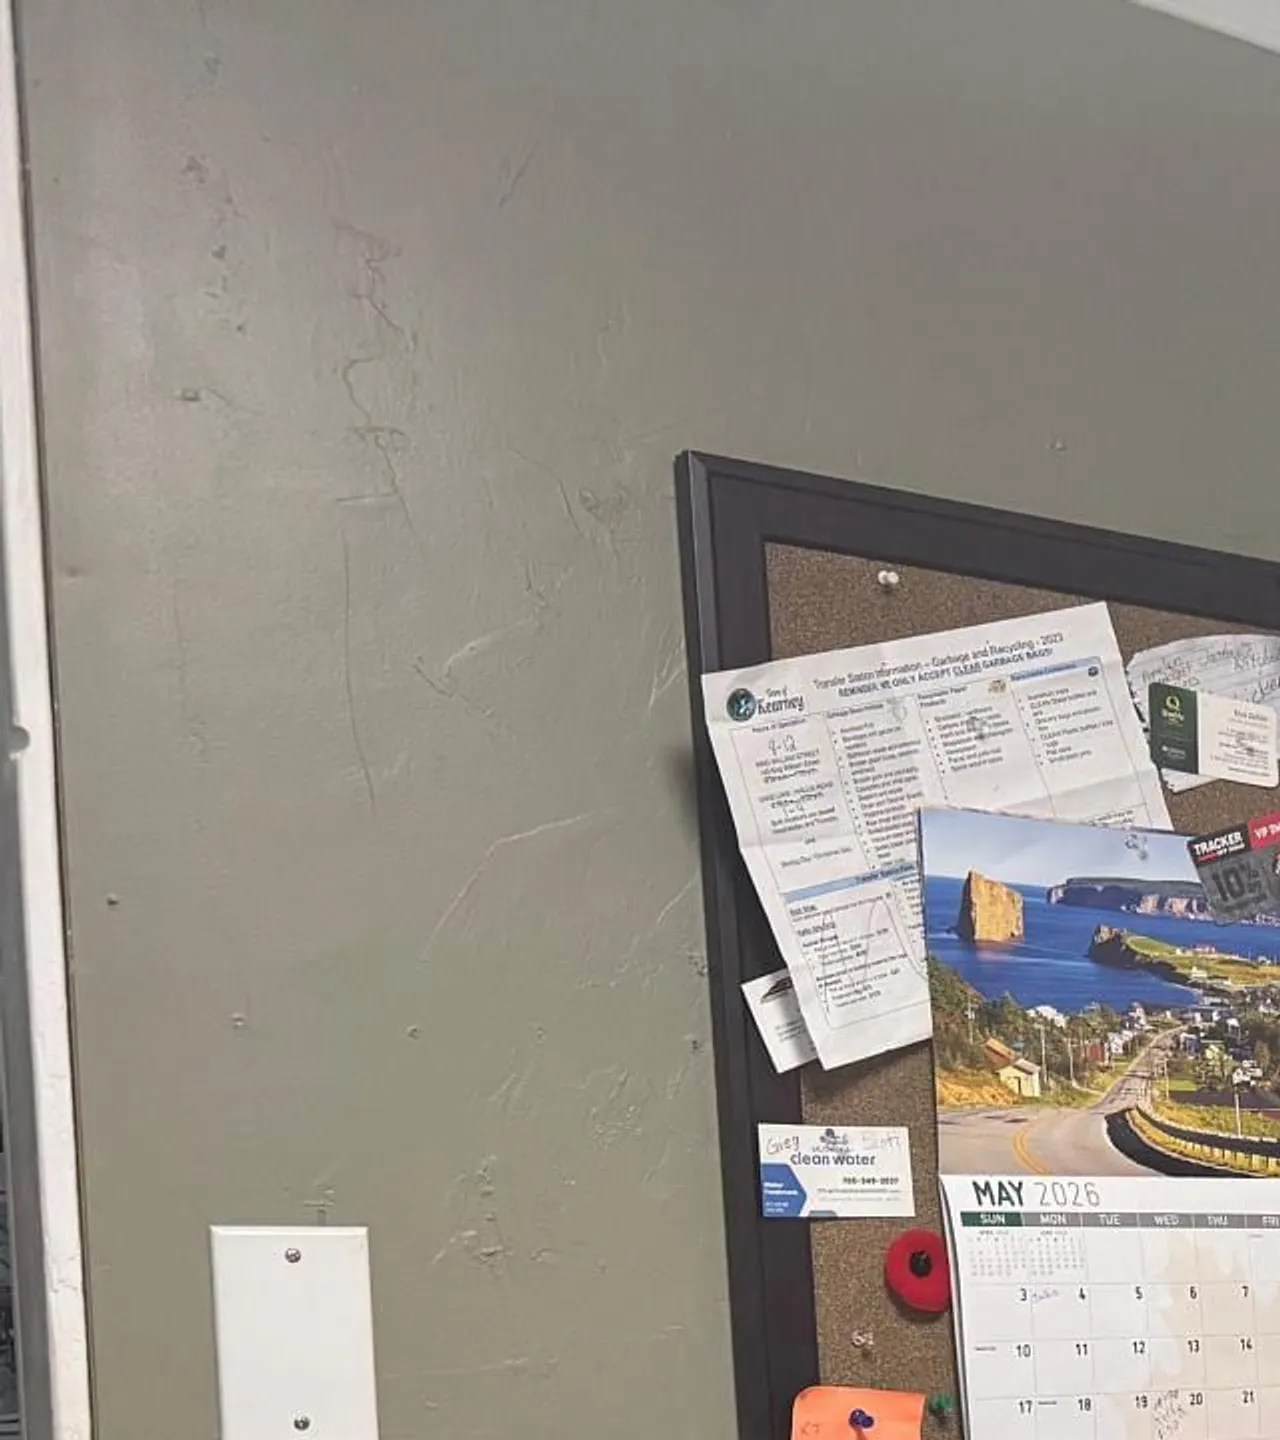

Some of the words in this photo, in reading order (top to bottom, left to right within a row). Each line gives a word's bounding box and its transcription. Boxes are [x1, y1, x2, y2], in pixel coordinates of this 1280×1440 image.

[757, 695, 804, 715] Kearney
[1193, 831, 1244, 857] TRACKER
[790, 1152, 831, 1166] clean
[833, 1153, 877, 1166] water
[972, 1180, 1024, 1207] MAY
[1033, 1181, 1102, 1208] 2026
[979, 1213, 1006, 1225] SUN
[1040, 1213, 1068, 1226] MON
[1099, 1214, 1122, 1226] TUE
[1153, 1214, 1180, 1226] WED
[1261, 1216, 1280, 1227] FRI
[1020, 1288, 1028, 1302] 3
[1078, 1287, 1087, 1301] 4
[1135, 1286, 1143, 1300] 5
[1189, 1285, 1198, 1300] 6
[1016, 1343, 1032, 1358] 10
[1075, 1343, 1089, 1356] 11
[1132, 1341, 1147, 1355] 12
[1187, 1339, 1201, 1353] 13
[1240, 1337, 1253, 1351] 14
[1018, 1400, 1033, 1414] 17
[1077, 1398, 1092, 1412] 18
[1134, 1394, 1148, 1409] 19
[1189, 1392, 1203, 1406] 20
[1242, 1390, 1255, 1404] 21
